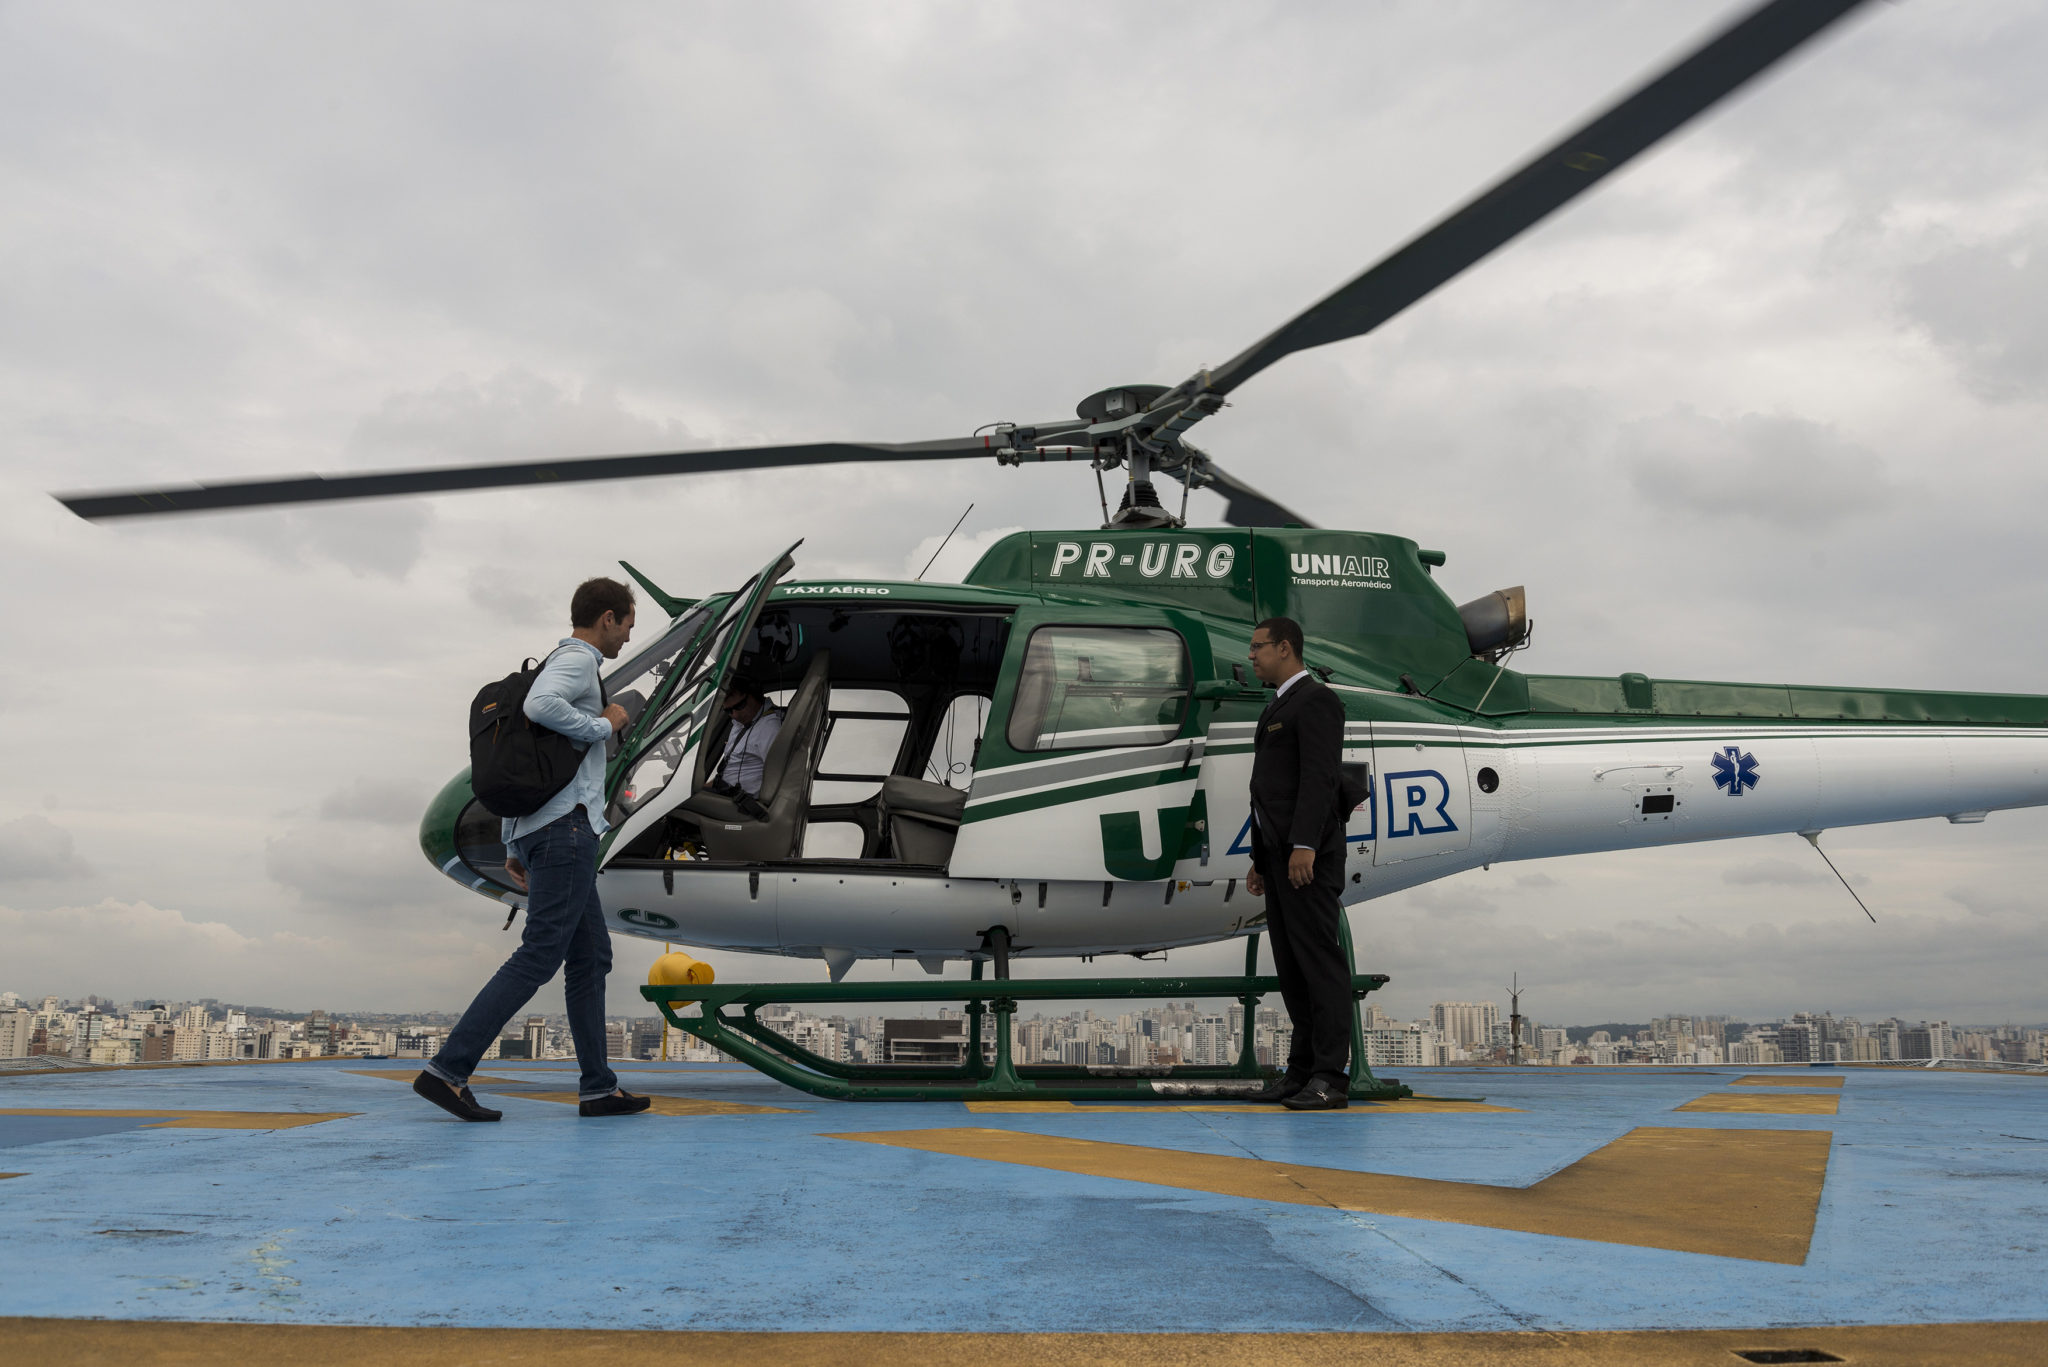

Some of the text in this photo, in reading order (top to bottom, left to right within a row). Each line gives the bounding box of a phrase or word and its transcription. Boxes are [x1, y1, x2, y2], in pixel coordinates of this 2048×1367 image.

[1050, 542, 1235, 578] PR-URG
[1290, 553, 1390, 578] UNIAIR
[828, 586, 890, 595] AÉREO
[1291, 576, 1392, 589] Transporte Aeromédico
